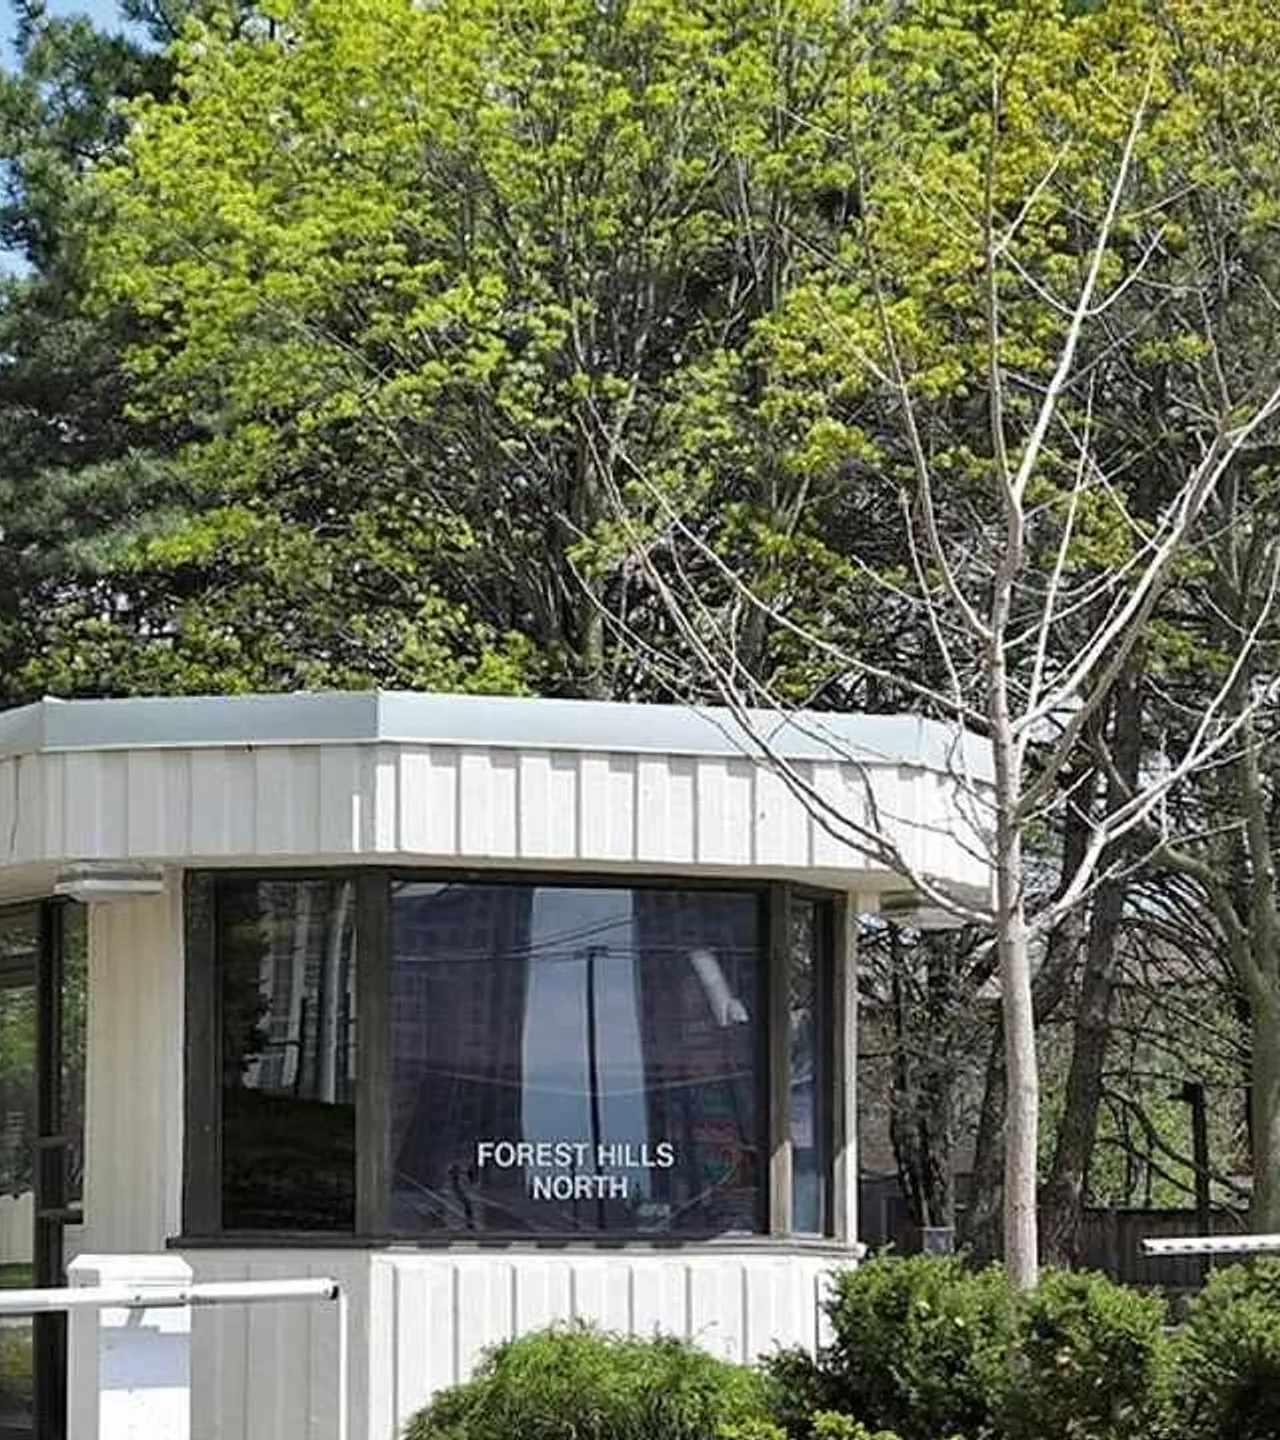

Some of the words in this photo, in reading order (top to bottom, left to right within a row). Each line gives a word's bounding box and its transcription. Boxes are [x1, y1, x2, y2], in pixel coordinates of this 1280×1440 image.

[476, 1142, 590, 1168] FOREST
[598, 1142, 675, 1168] HILLS
[532, 1175, 629, 1200] NORTH
